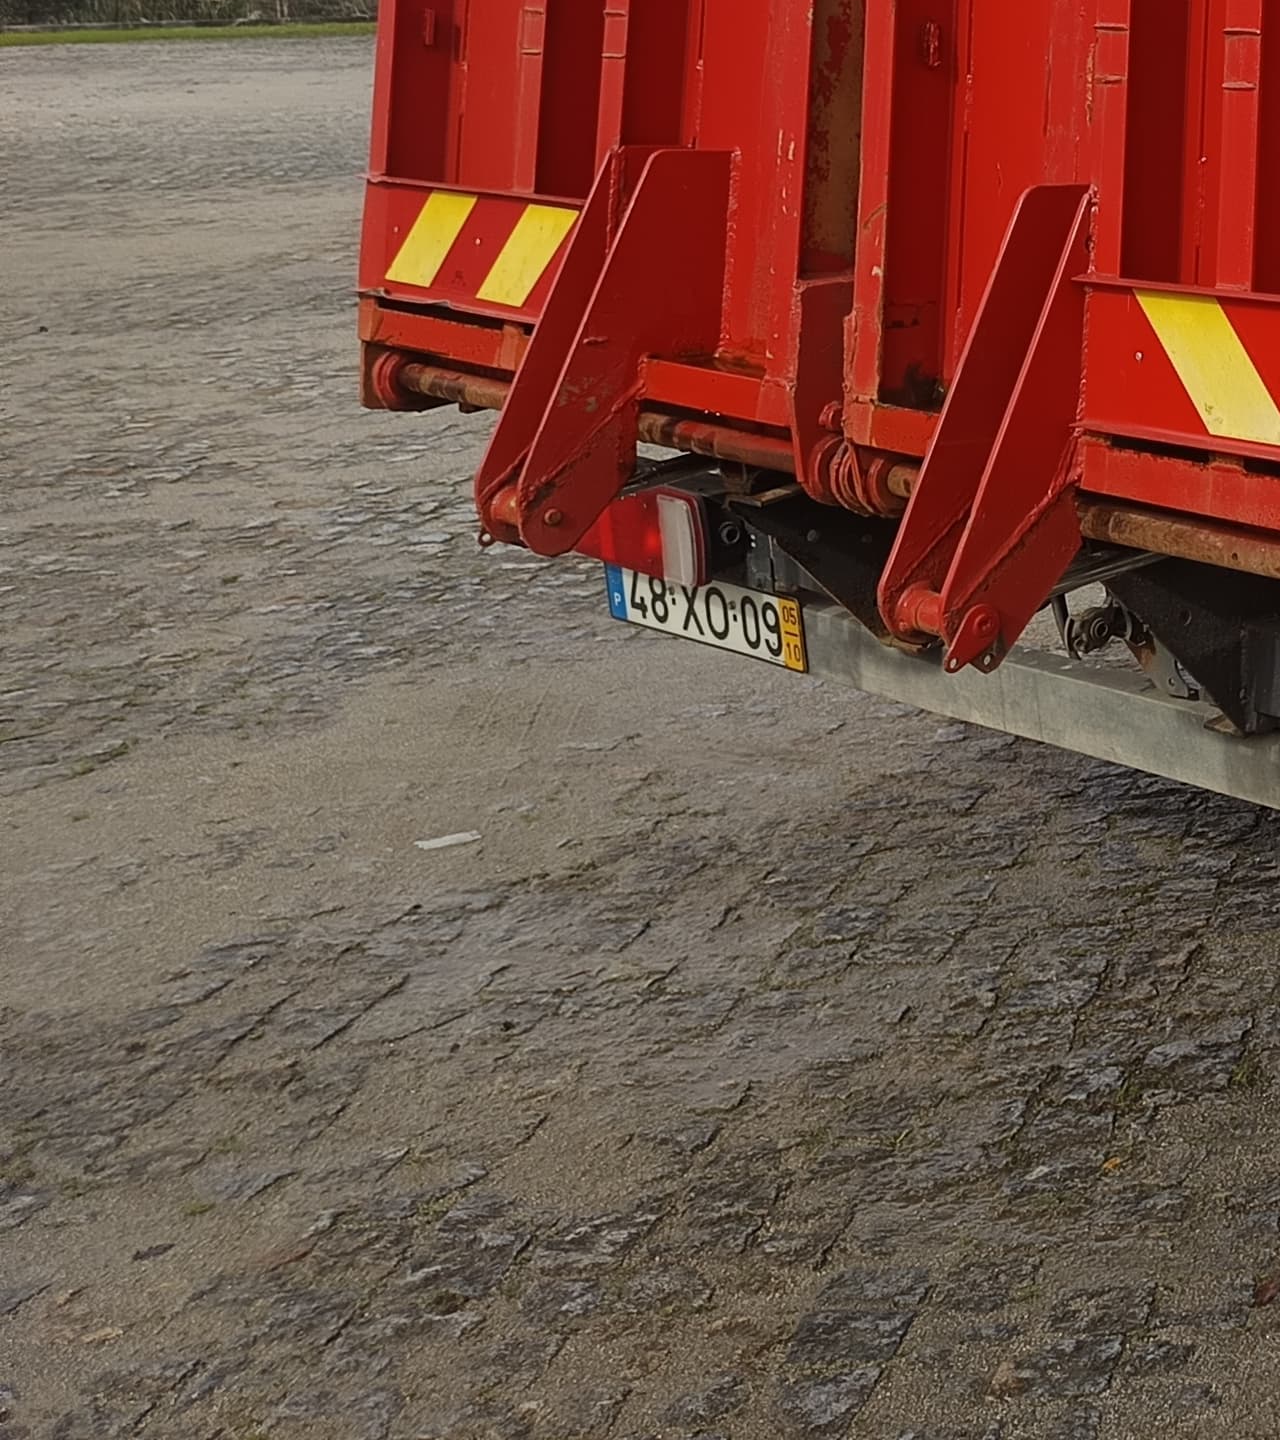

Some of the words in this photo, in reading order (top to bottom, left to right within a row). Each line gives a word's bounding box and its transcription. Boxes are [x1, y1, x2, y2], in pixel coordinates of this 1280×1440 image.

[613, 591, 621, 606] P
[782, 605, 797, 626] 05
[786, 642, 801, 662] 10
